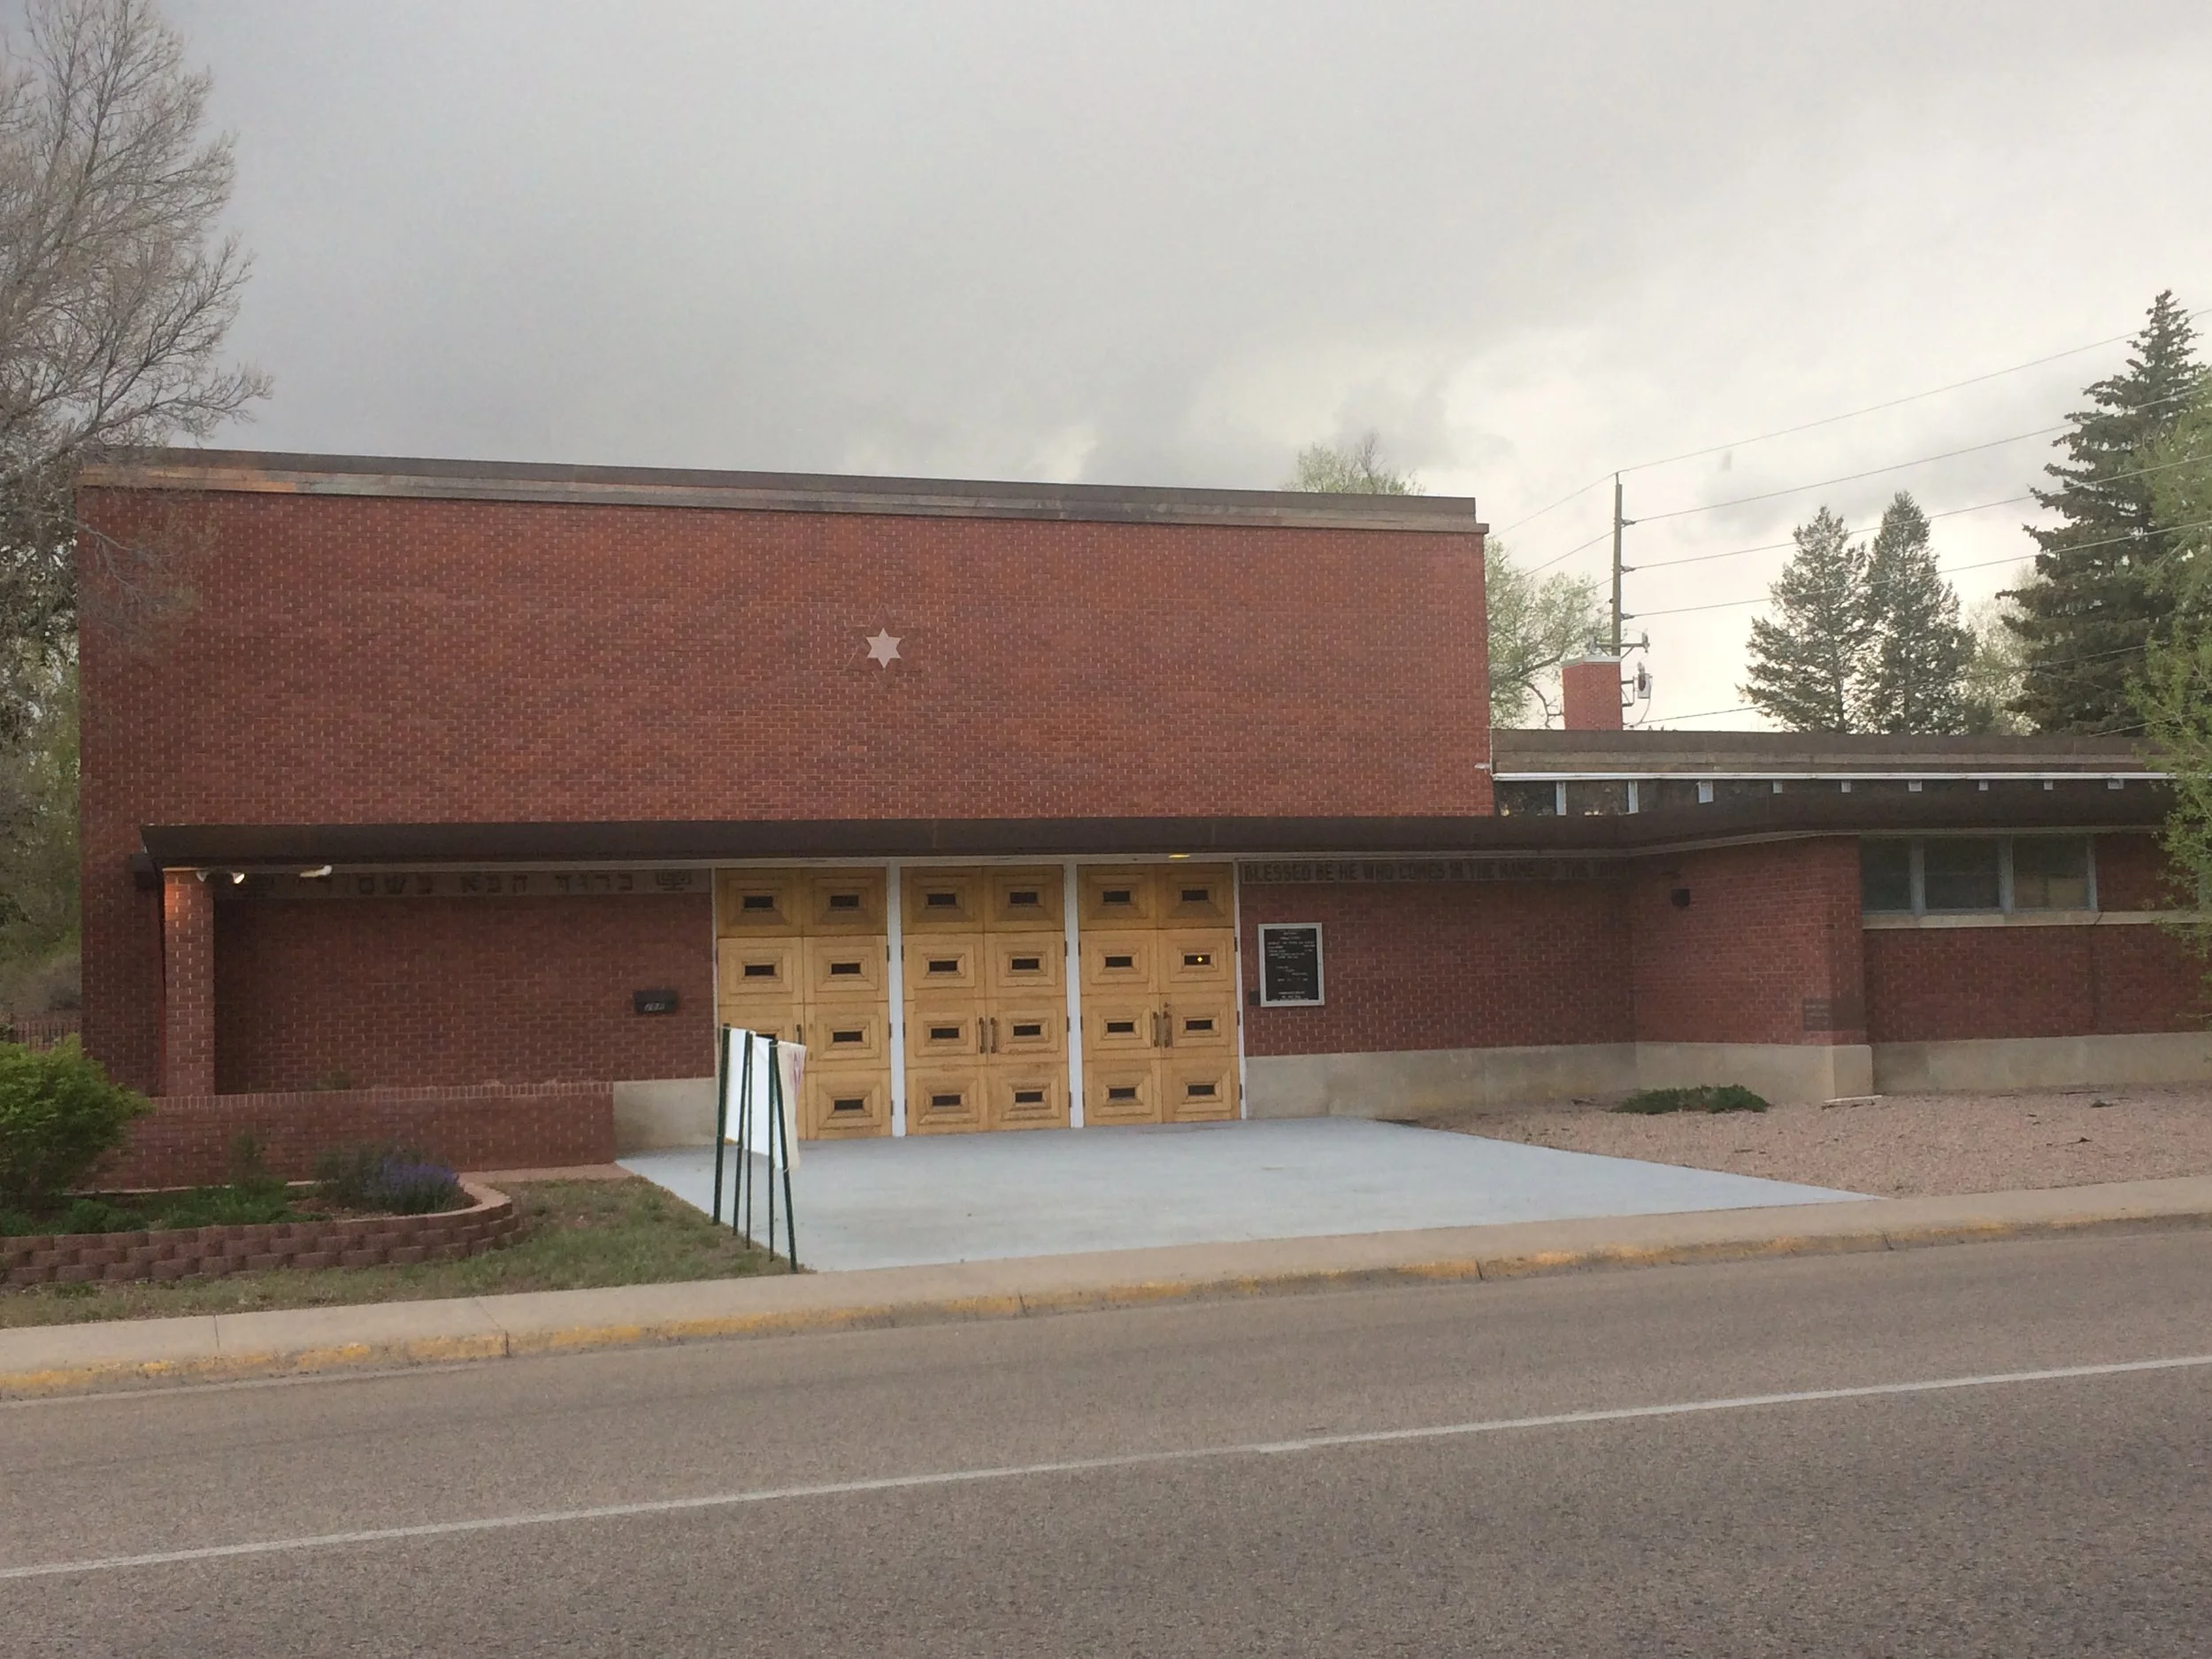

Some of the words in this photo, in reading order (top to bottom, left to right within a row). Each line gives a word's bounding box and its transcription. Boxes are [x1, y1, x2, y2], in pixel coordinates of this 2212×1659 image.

[1244, 863, 1312, 882] BLESSED
[1316, 863, 1334, 881] BE
[1339, 862, 1357, 880] HE
[1363, 862, 1394, 879] WHO
[1400, 861, 1446, 879] COMES
